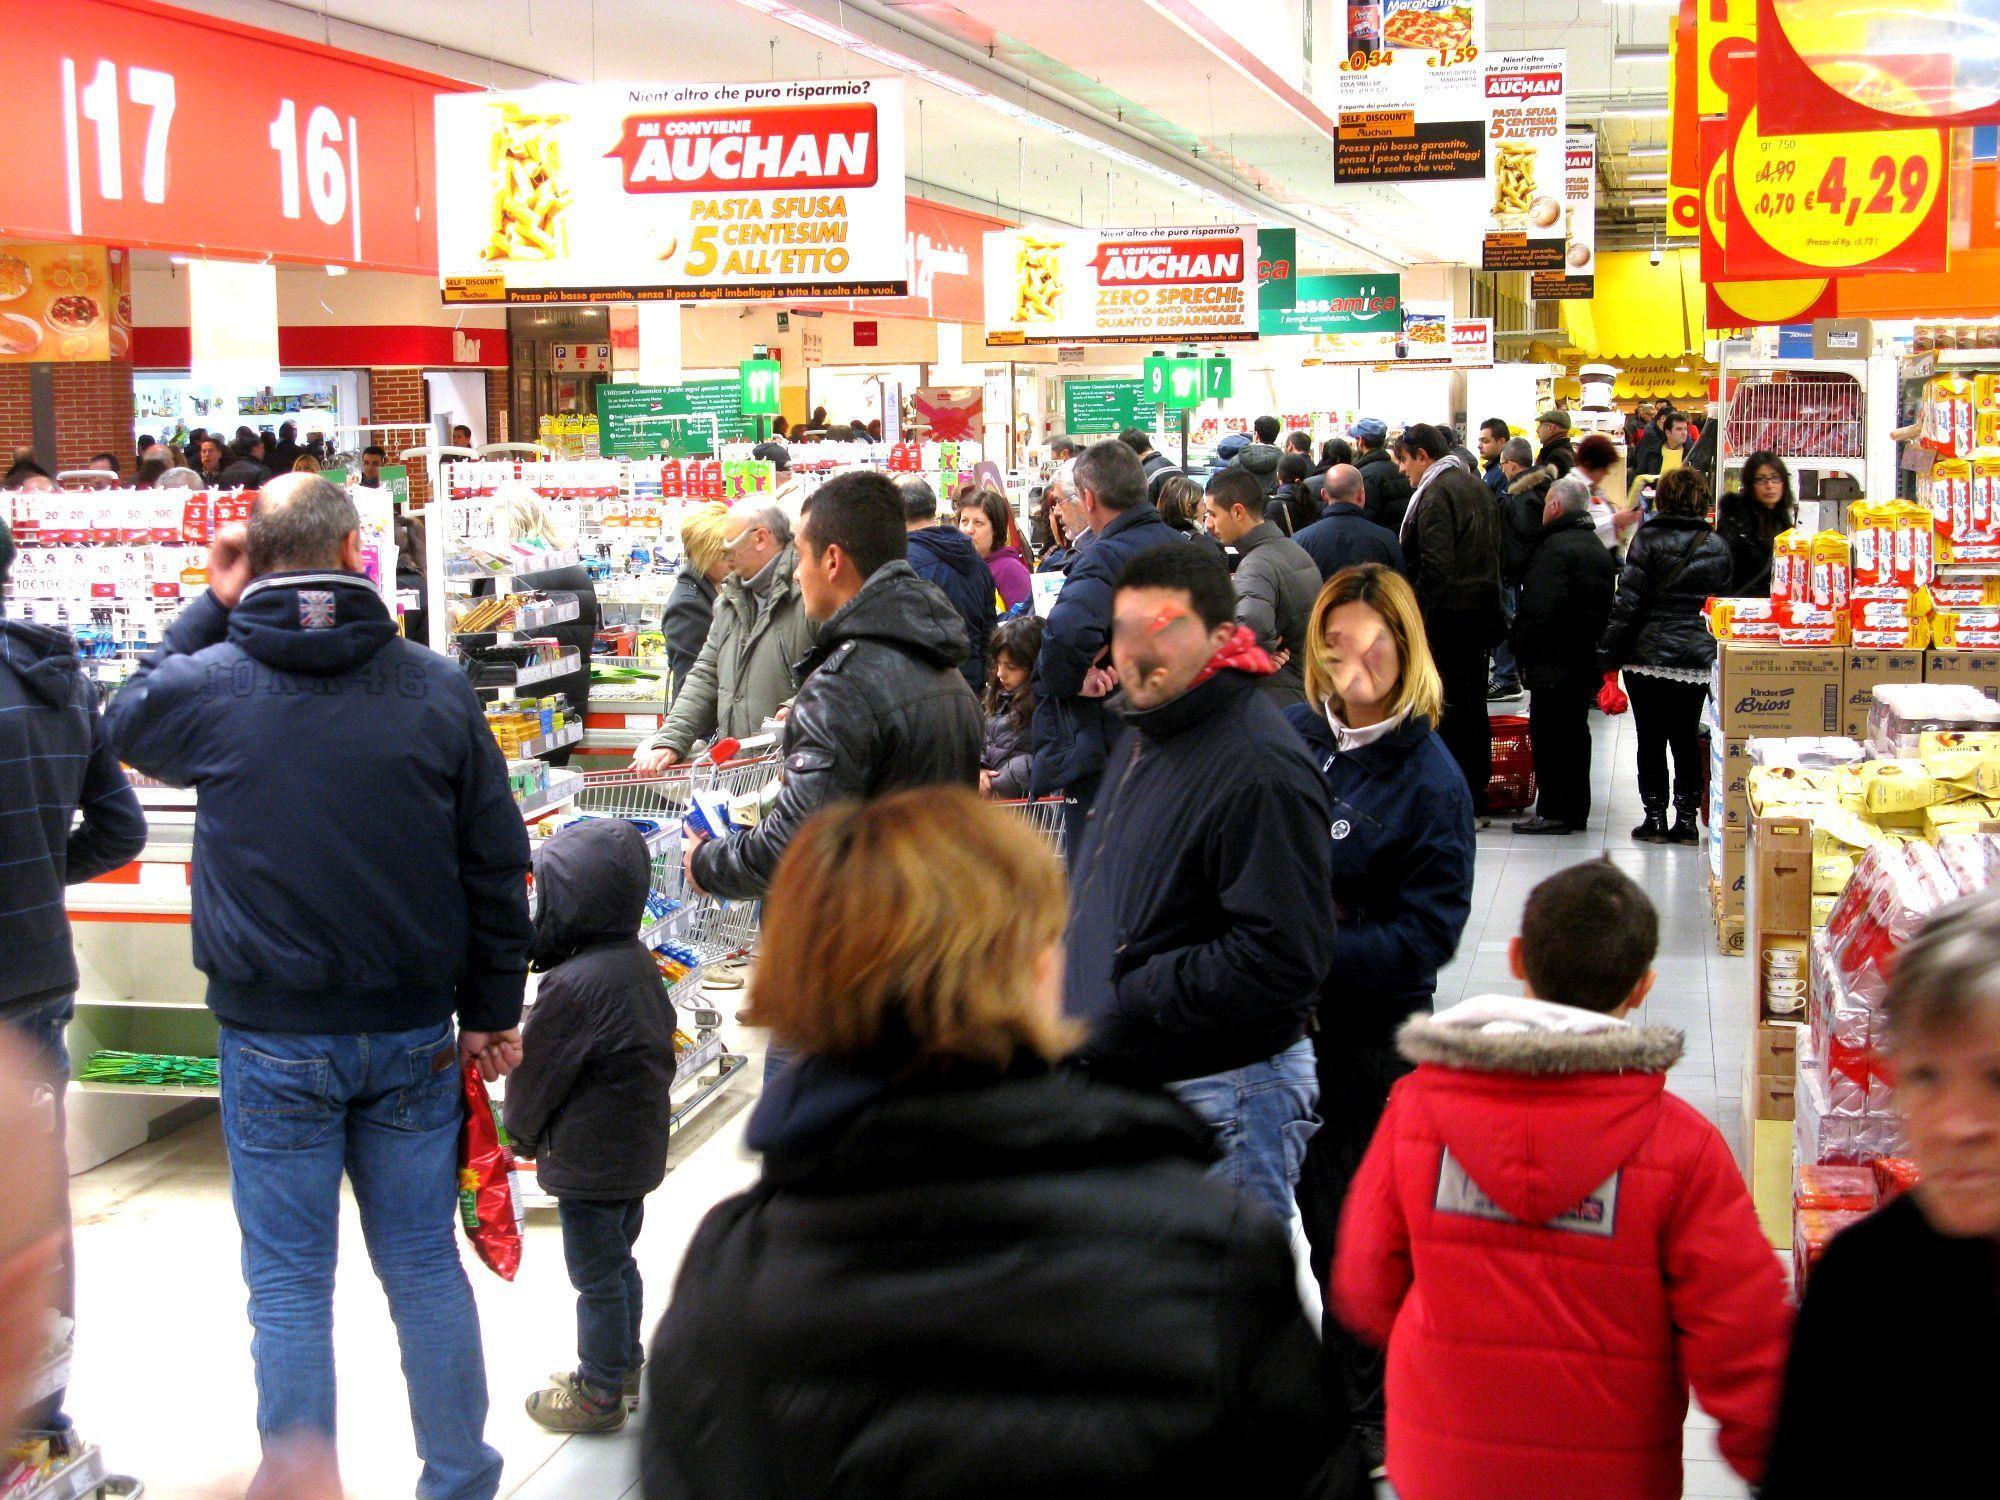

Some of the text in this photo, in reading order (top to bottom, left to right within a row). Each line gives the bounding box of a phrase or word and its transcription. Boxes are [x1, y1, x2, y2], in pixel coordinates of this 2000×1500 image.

[1521, 63, 1562, 71] risparmio?
[714, 84, 740, 100] che
[745, 87, 781, 102] puro
[786, 81, 871, 99] risparmio?
[1488, 80, 1560, 94] AUCHAN
[1341, 113, 1407, 123] SELF DISCOUNT
[1493, 108, 1557, 118] PASTA SFUSA
[637, 120, 751, 137] MI CONVIENE
[1357, 129, 1392, 137] Auchan
[1490, 117, 1557, 139] 5 CENTESIMI
[1505, 126, 1557, 138] ALL'ETTO
[82, 60, 347, 225] 17 16
[1339, 139, 1469, 154] Prezzo più basso garantito,
[1761, 140, 1796, 153] gr 750
[630, 132, 870, 182] AUCHAN
[1339, 150, 1480, 165] senza il peso degli imballaggi
[1566, 156, 1591, 167] HAN
[1348, 166, 1369, 174] tutta
[1372, 165, 1381, 174] la
[1384, 163, 1411, 173] scelta
[1414, 162, 1430, 172] che
[1433, 162, 1456, 171] vuoi.
[690, 196, 848, 220] PASTA SFUSA
[1150, 228, 1165, 237] che
[1168, 228, 1188, 238] puro
[1192, 226, 1240, 236] risparmio?
[684, 221, 849, 277] 5 CENTESIMI
[722, 247, 850, 275] ALL'ETTO
[1101, 254, 1239, 280] AUCHAN
[446, 278, 499, 286] SELF DISCOUNT
[460, 291, 488, 299] Auchan
[511, 292, 541, 301] Prezzo
[544, 291, 558, 302] più
[560, 290, 588, 301] basso
[590, 290, 635, 302] garantito,
[638, 290, 664, 299] senza
[666, 290, 672, 299] il
[674, 290, 696, 301] peso
[700, 288, 722, 299] degli
[725, 287, 775, 299] imballaggi
[786, 287, 808, 296] tutta
[812, 286, 820, 296] la
[824, 286, 850, 296] scelta
[853, 286, 869, 295] che
[872, 286, 896, 295] vuoi.
[1096, 286, 1245, 306] ZERO SPRECHI:
[1096, 314, 1245, 328] QUANTO RISPARMIARE.
[453, 331, 480, 362] Bar
[1152, 366, 1162, 394] 9
[1214, 366, 1223, 390] 7
[720, 385, 741, 393] sempli
[1734, 696, 1791, 714] Brioss
